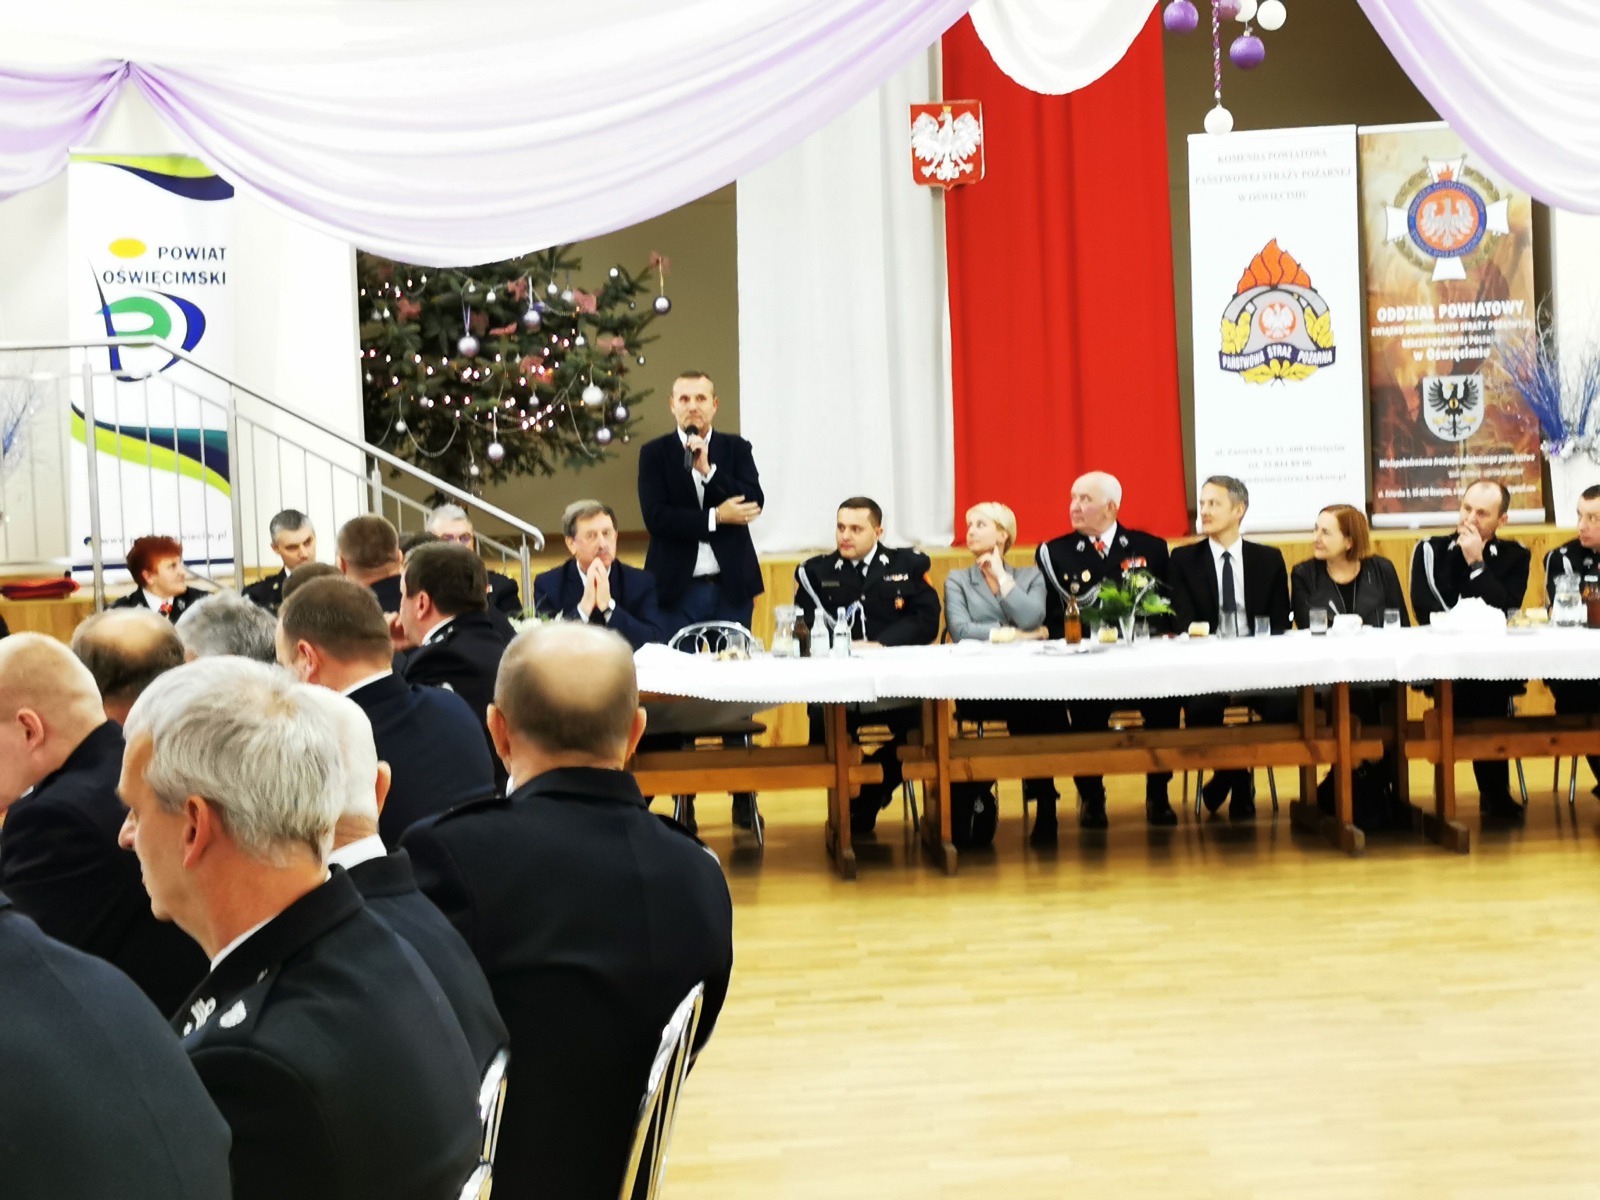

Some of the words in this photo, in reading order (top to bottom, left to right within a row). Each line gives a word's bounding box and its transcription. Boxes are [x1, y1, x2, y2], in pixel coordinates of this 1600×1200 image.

[158, 246, 227, 261] POWIAT
[102, 268, 227, 287] OŚWIĘCIMSKI
[1376, 304, 1435, 323] ODDZIAŁ
[1438, 300, 1525, 319] POWIATOWY
